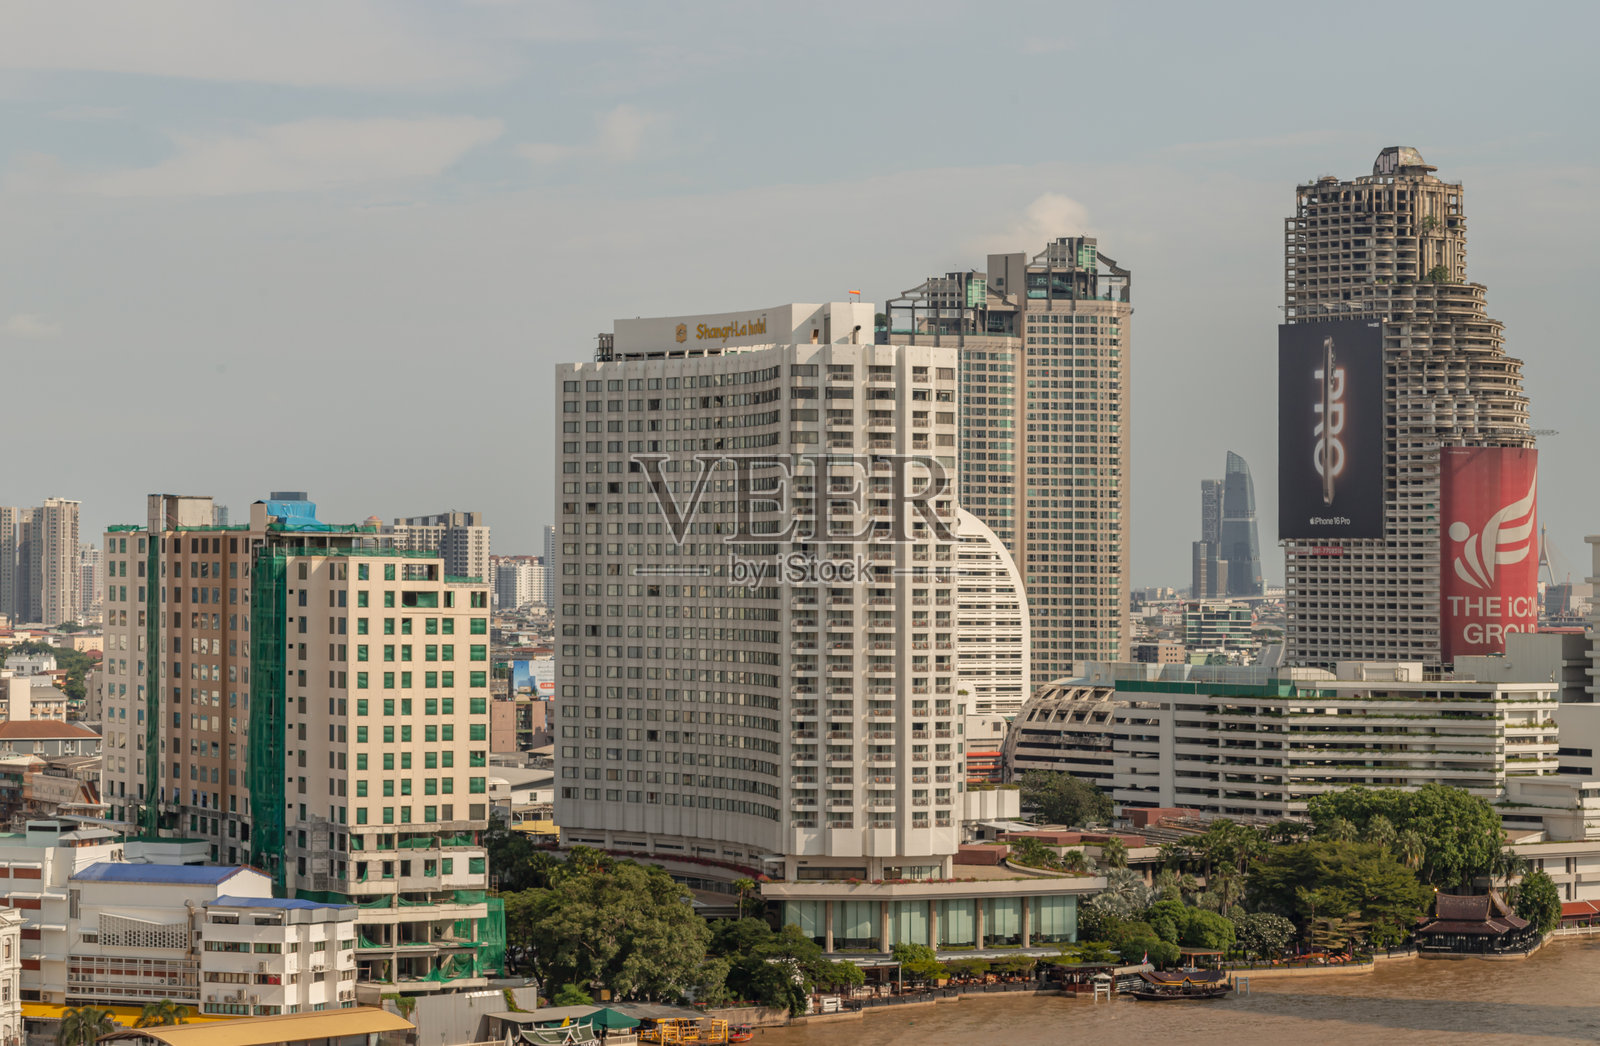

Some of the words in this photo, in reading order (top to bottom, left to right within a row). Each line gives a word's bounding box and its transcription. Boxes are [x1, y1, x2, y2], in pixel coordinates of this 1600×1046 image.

[1314, 369, 1344, 477] PRO
[1314, 517, 1334, 525] iPhone
[1341, 517, 1351, 525] Pro
[1447, 596, 1502, 617] THE
